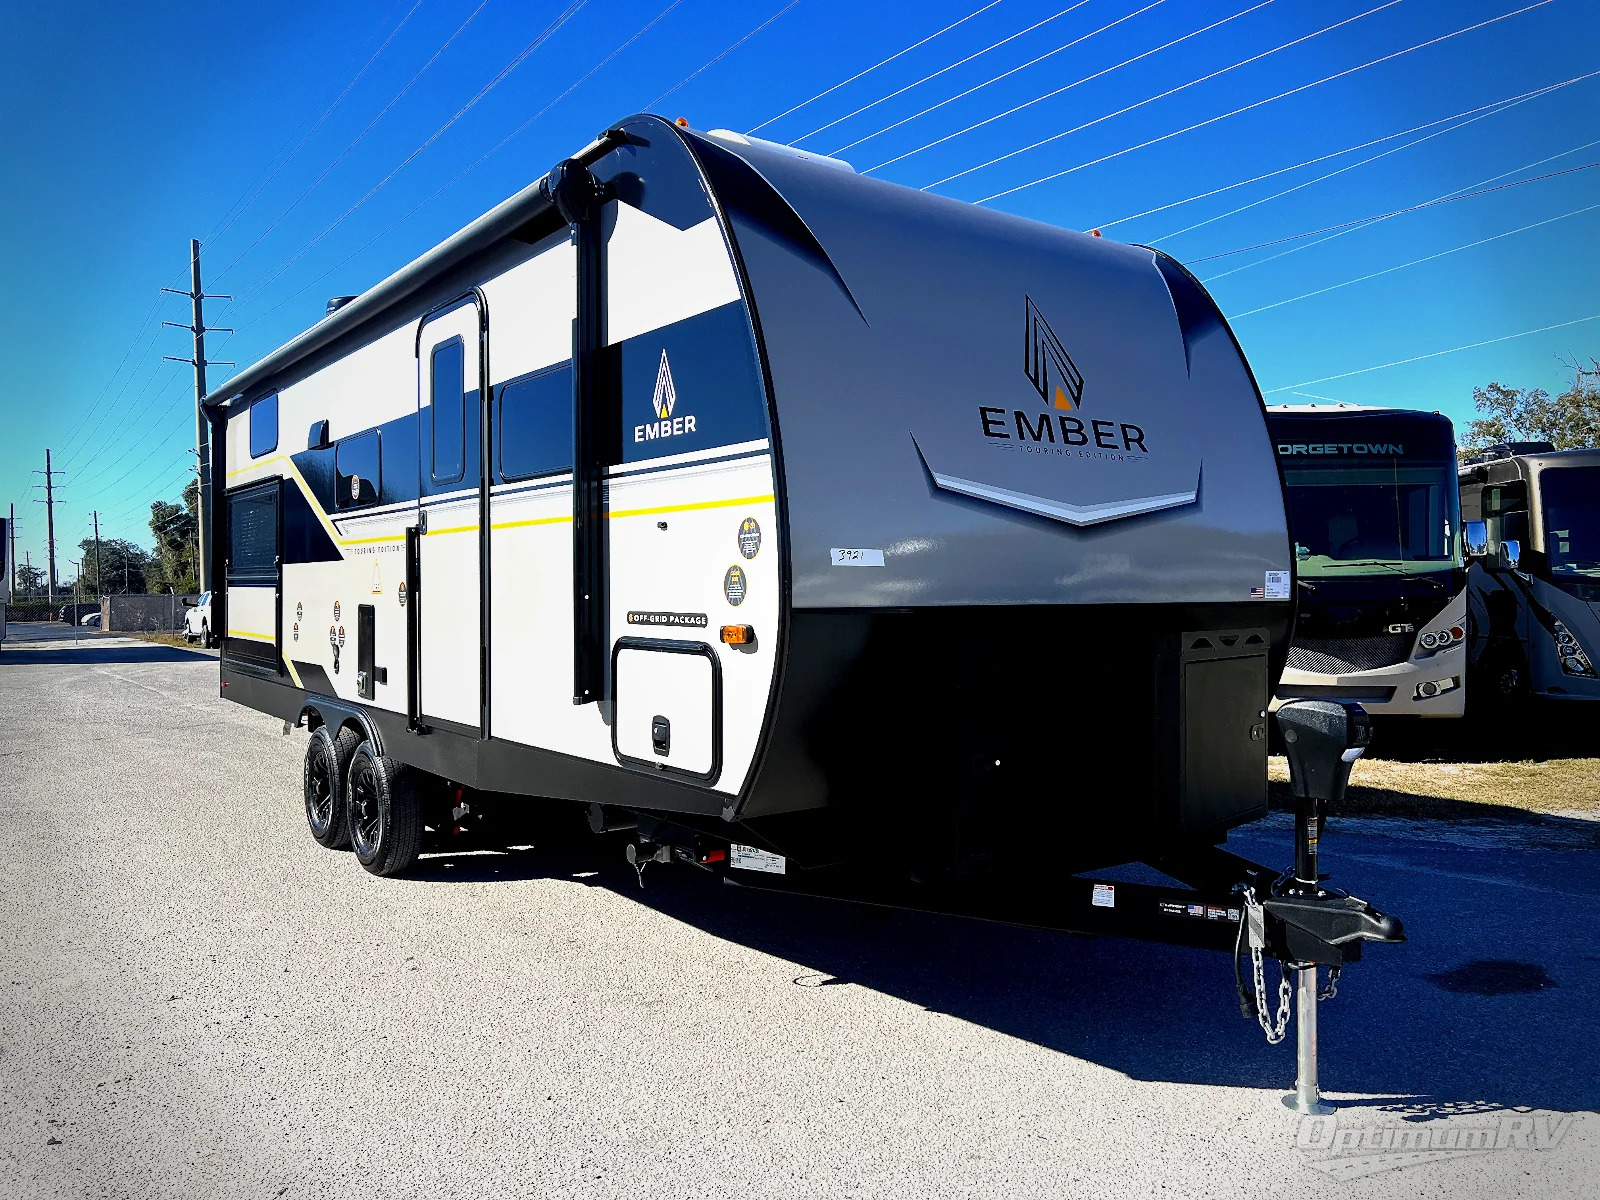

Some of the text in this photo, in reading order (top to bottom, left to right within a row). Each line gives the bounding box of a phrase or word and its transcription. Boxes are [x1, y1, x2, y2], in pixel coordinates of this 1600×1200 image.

[634, 415, 696, 442] EMBER
[979, 406, 1149, 453] EMBER
[1019, 445, 1125, 462] TOURING EDITION
[354, 545, 400, 555] TOURING EDITION
[838, 549, 864, 562] 3921
[633, 614, 707, 625] OFF-GRID PACKAGE
